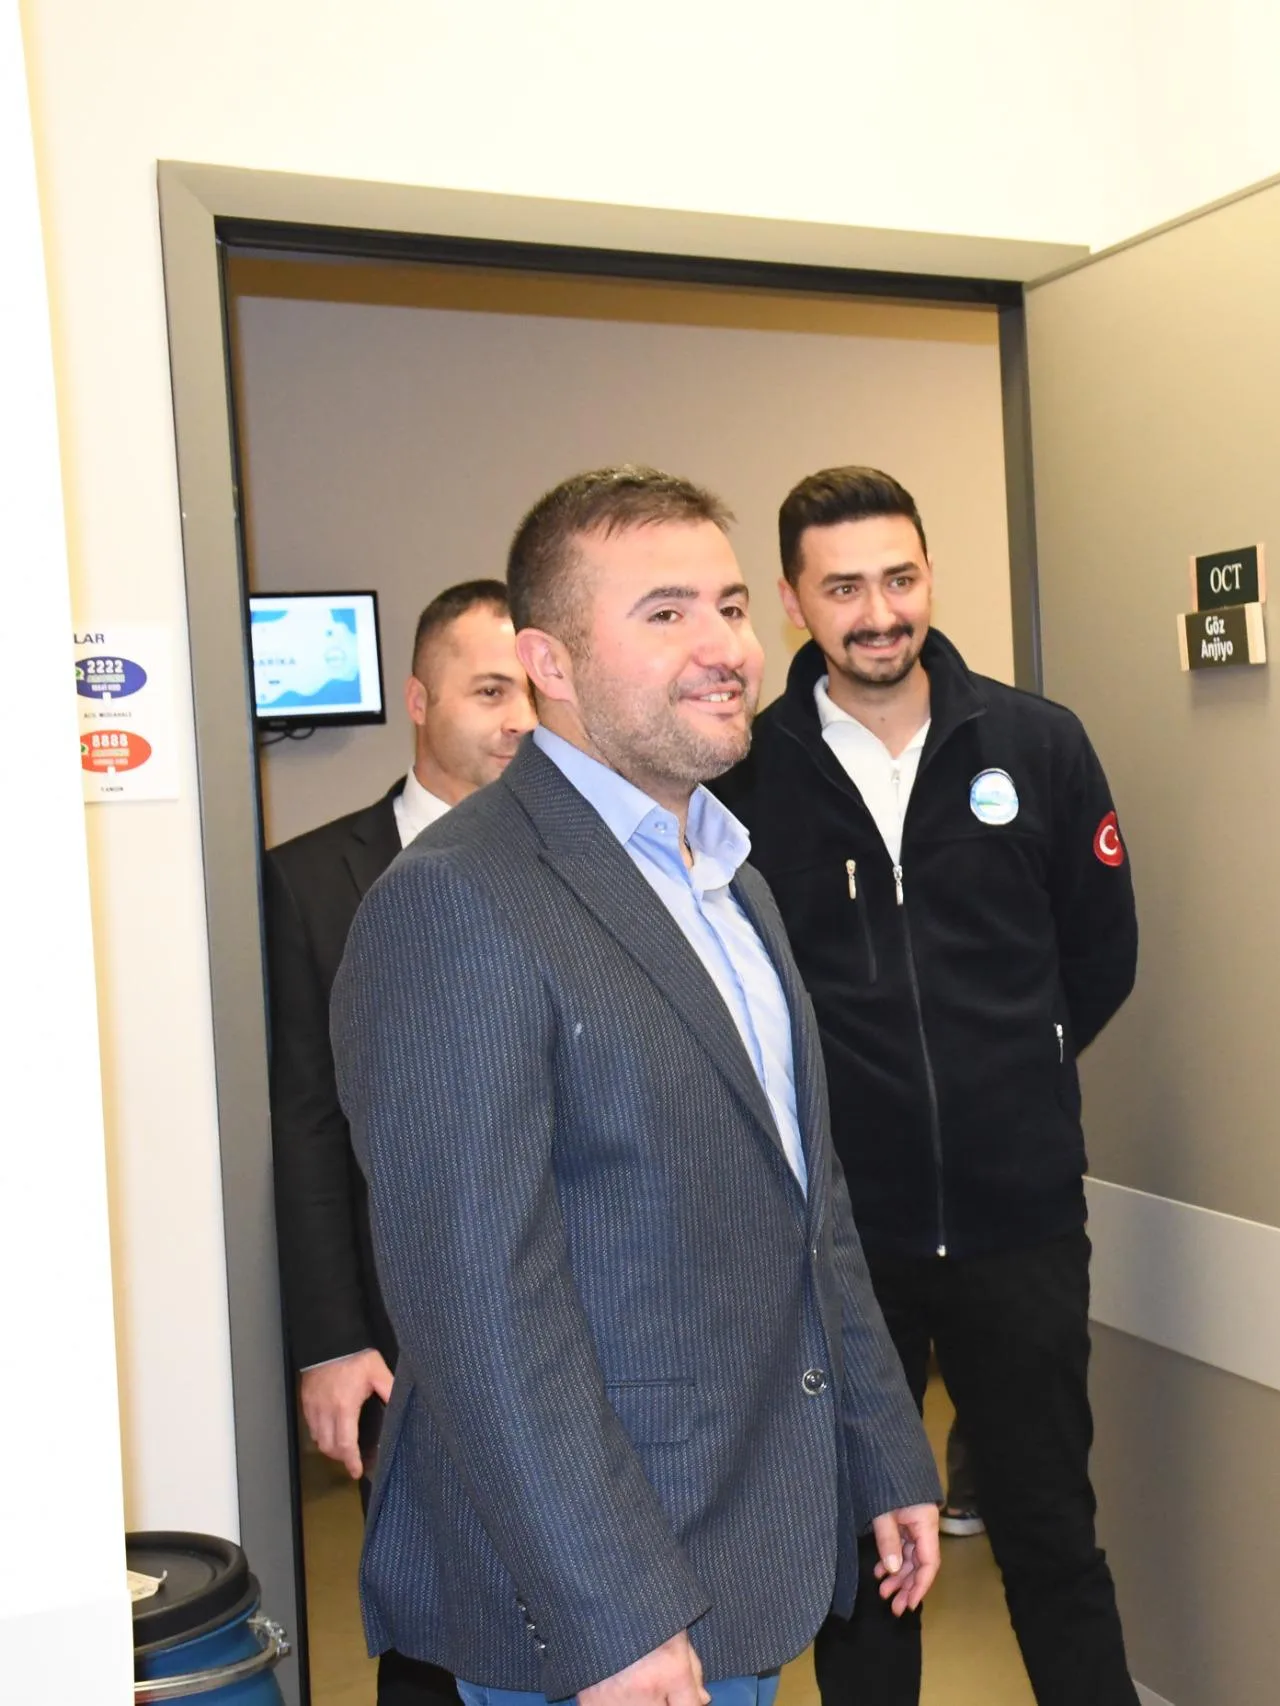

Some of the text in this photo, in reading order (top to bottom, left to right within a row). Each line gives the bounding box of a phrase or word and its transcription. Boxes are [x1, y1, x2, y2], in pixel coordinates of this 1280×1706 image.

[1210, 563, 1242, 593] OCT
[1205, 615, 1226, 635] Göz
[1201, 638, 1233, 661] Anjiyo
[87, 659, 123, 674] 2222
[92, 734, 128, 747] 8888
